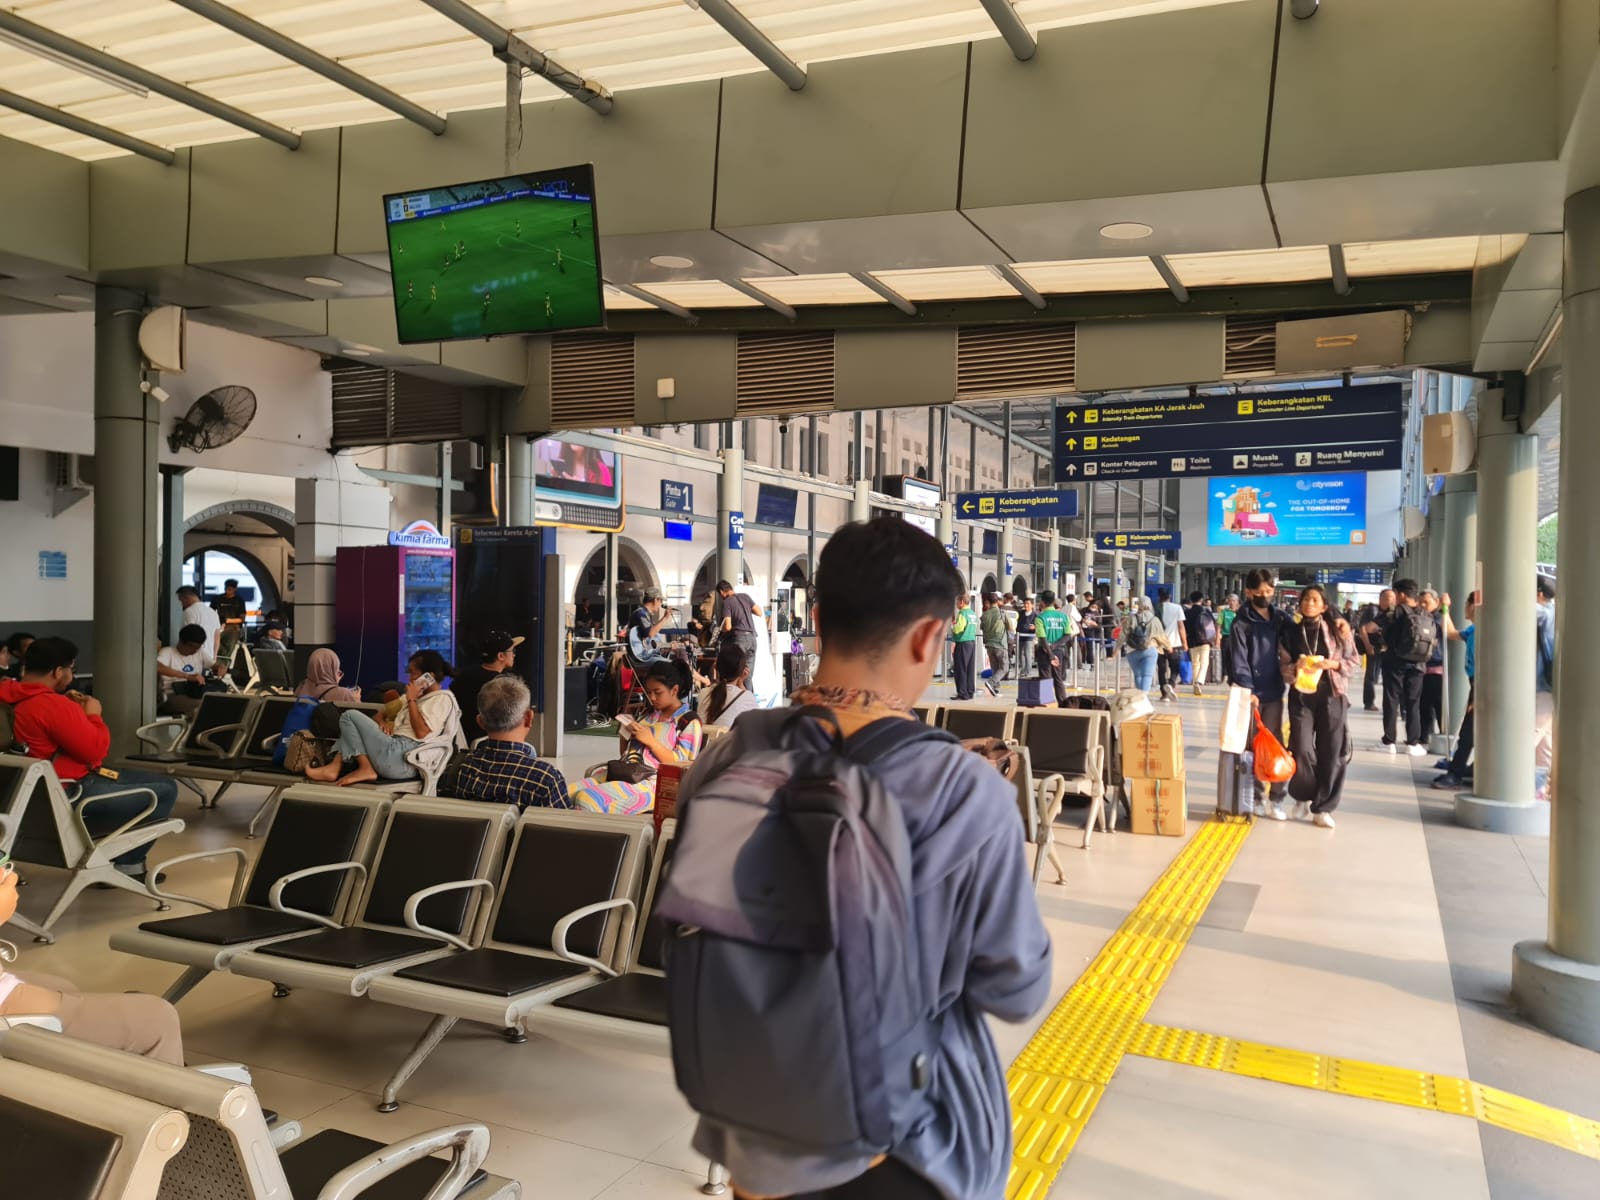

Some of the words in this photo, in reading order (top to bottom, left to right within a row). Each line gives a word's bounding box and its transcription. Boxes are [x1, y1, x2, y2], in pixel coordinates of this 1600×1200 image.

[1257, 395, 1316, 406] Keberangkatan
[1317, 394, 1333, 402] KRL
[1102, 406, 1153, 415] Keberangkatan
[1167, 403, 1186, 411] Jarak
[1187, 402, 1205, 410] Jauh
[1101, 435, 1140, 443] Kedatangan
[1252, 454, 1278, 462] Musala
[1317, 451, 1342, 461] Ruang
[1343, 449, 1384, 458] Menyusui
[1311, 481, 1344, 489] cityvision
[665, 483, 681, 497] Pintu
[682, 485, 691, 511] 1
[999, 496, 1059, 506] Keberangkatan
[395, 533, 421, 543] kimia
[1130, 533, 1172, 541] Keberangkatan
